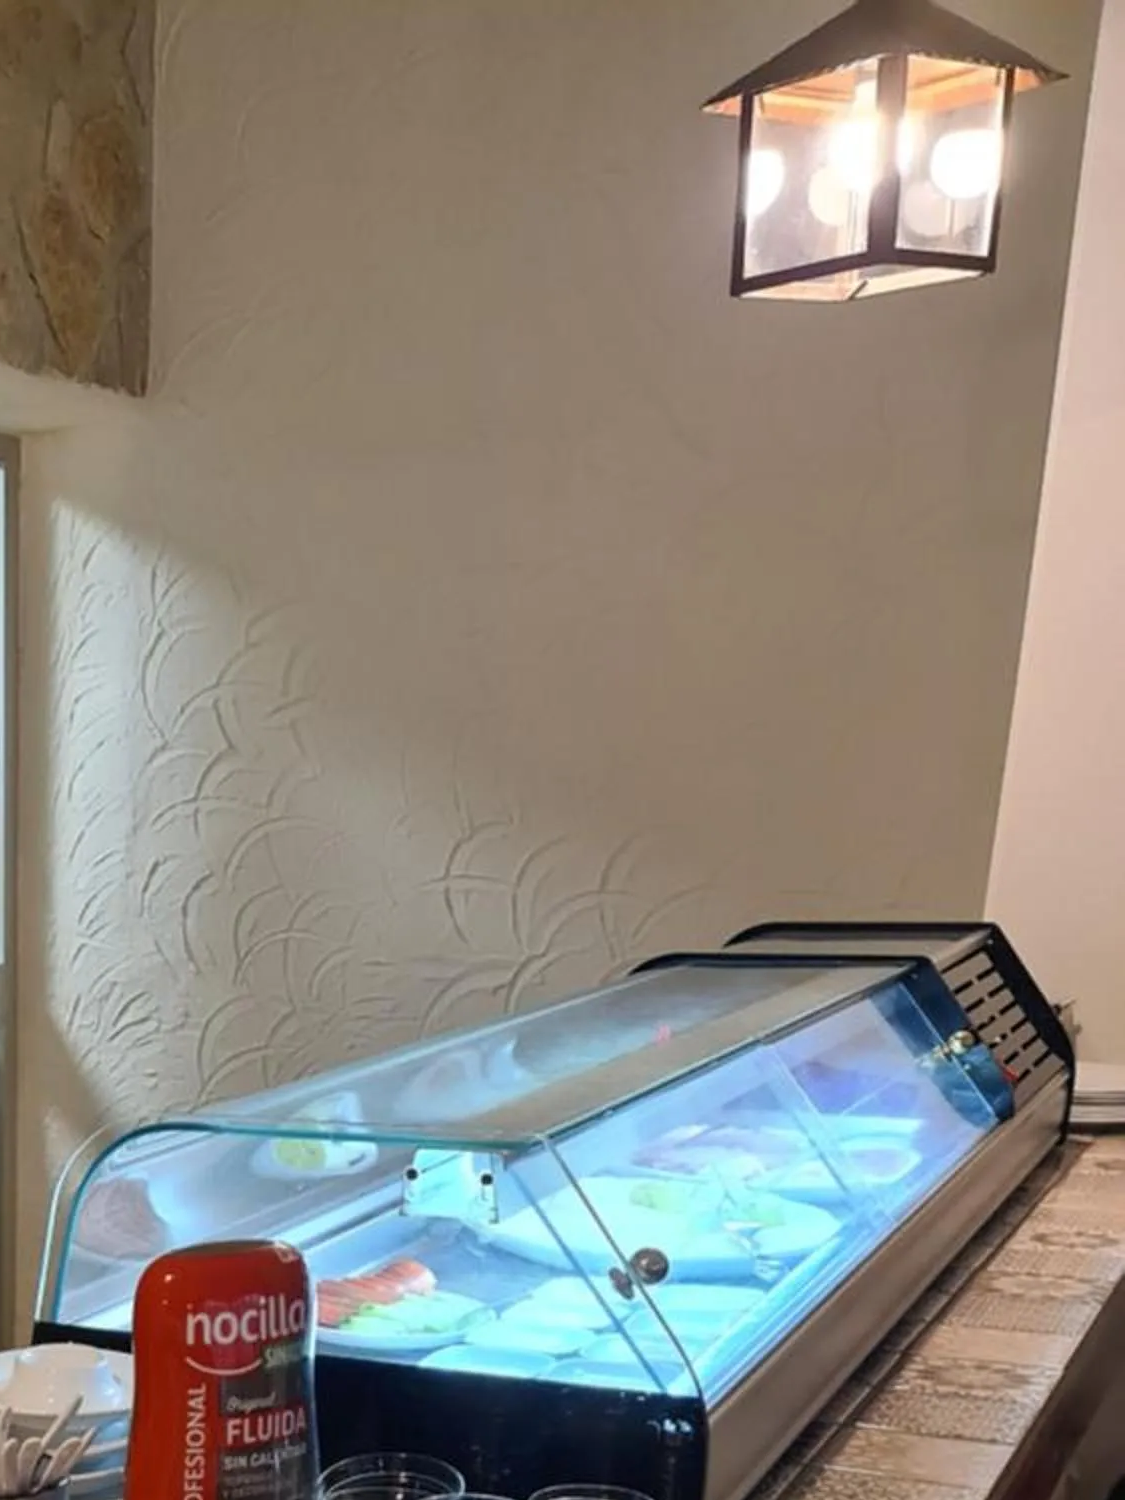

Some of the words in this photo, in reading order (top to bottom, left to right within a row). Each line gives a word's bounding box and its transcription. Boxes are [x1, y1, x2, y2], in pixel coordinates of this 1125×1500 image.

[186, 1294, 305, 1346] nocilla
[227, 1407, 306, 1446] FLUIDA
[224, 1455, 248, 1470] SIN
